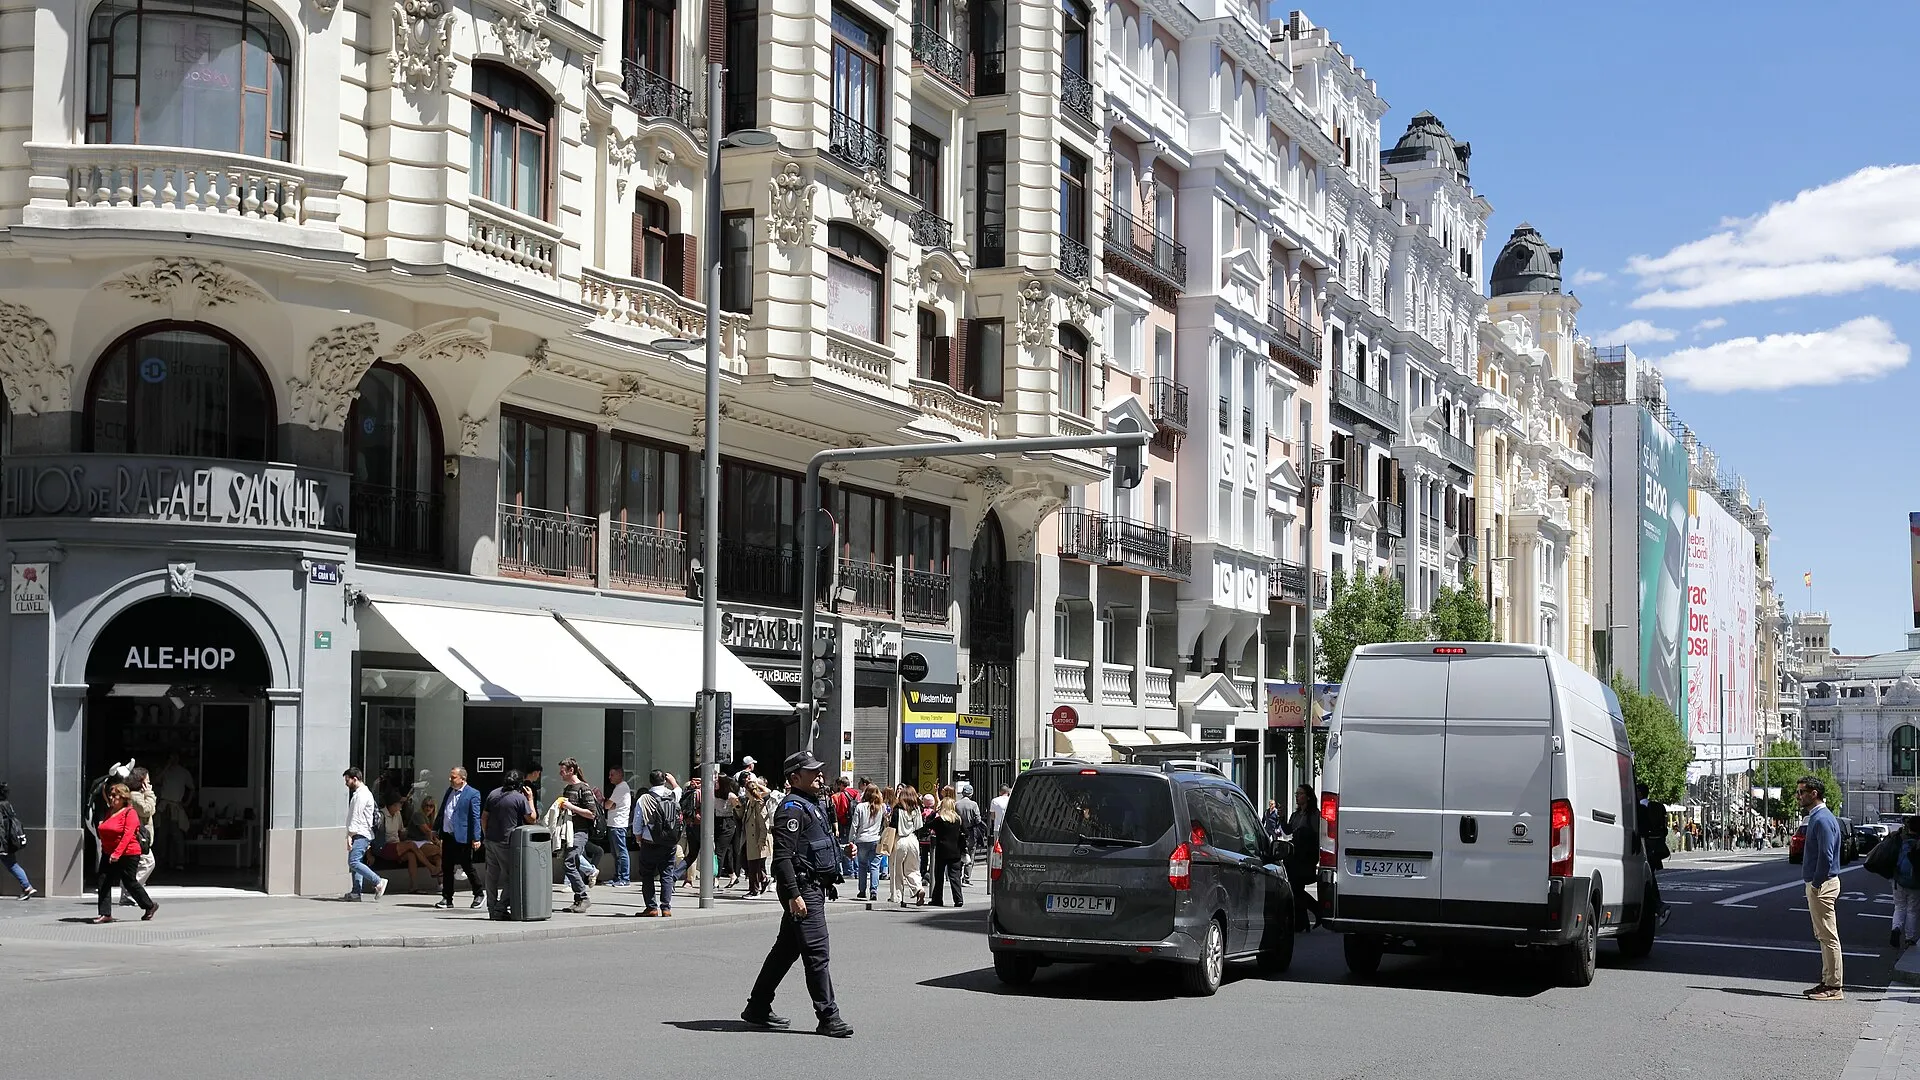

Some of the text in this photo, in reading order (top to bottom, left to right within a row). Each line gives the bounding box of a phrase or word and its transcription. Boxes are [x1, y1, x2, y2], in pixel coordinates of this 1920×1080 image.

[170, 361, 225, 379] Electry
[4, 465, 84, 516] HIJOS
[88, 488, 110, 513] DE
[116, 465, 223, 519] RAFAEL
[229, 472, 329, 526] SANCHEZ
[317, 571, 328, 580] GRAN
[14, 594, 34, 602] CALLE
[16, 602, 44, 612] CLAVEL
[1688, 608, 1709, 632] bre
[721, 612, 837, 647] STEAKBUER
[854, 638, 871, 649] SINCE
[124, 646, 236, 670] ALE-HOP
[920, 693, 940, 703] Western
[940, 693, 954, 704] Union
[1270, 696, 1285, 706] SAN
[1274, 704, 1301, 715] ISIDRO
[931, 728, 947, 739] CHANGE
[480, 761, 502, 769] ALE-HOP
[1364, 862, 1418, 874] 5437 KXL
[1056, 896, 1112, 911] 1902 LFW
